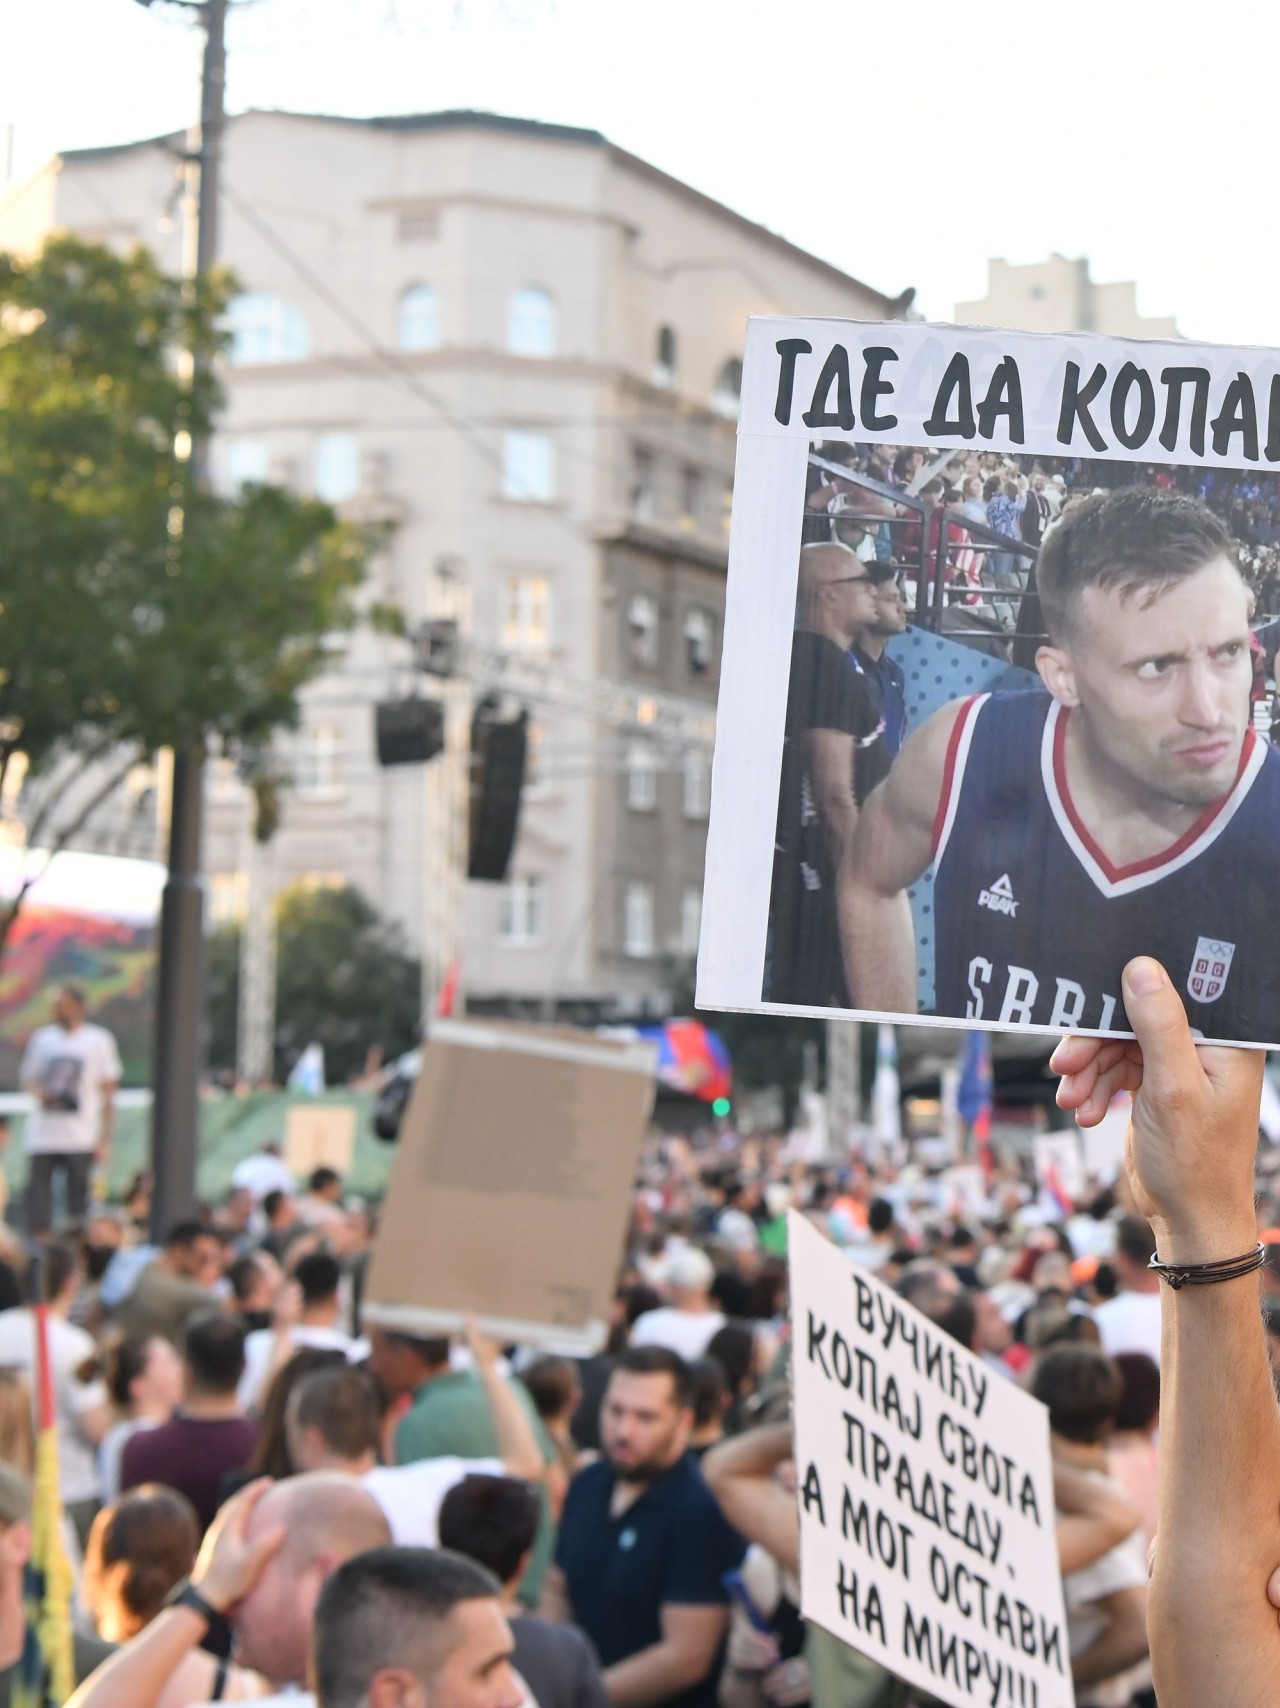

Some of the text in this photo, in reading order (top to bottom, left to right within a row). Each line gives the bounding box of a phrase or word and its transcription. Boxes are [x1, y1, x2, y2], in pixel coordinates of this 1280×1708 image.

[774, 338, 899, 432] ГДЕ
[922, 351, 1025, 445] ДА
[977, 889, 1019, 918] PEAK
[808, 1310, 923, 1442] КОПАЈ
[853, 1274, 988, 1419] ВУЧИЋУ
[800, 1461, 827, 1527] А
[929, 1545, 1064, 1676] ОСТАВИ
[836, 1559, 887, 1647] НА
